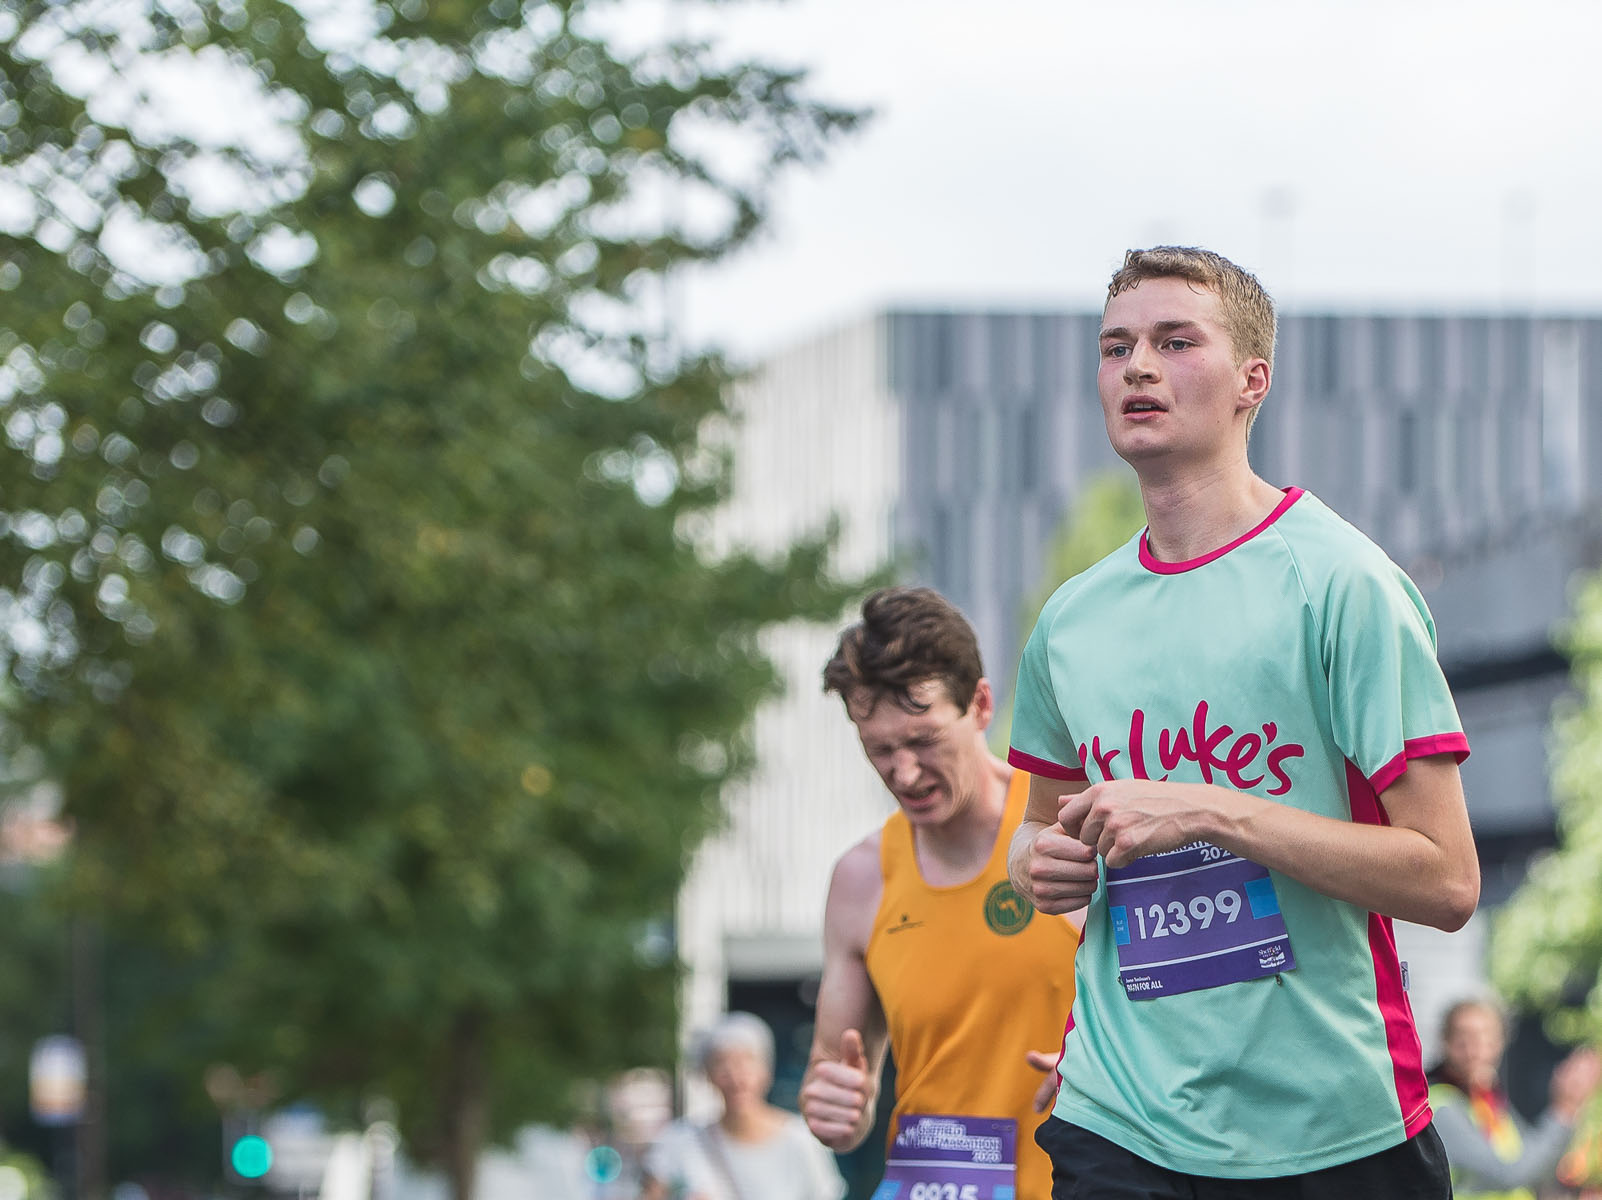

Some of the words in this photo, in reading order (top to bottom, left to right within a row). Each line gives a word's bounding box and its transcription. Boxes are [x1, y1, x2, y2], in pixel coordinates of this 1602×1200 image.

[1134, 889, 1242, 940] 12399
[1139, 981, 1151, 990] FOR
[1151, 980, 1163, 989] ALL
